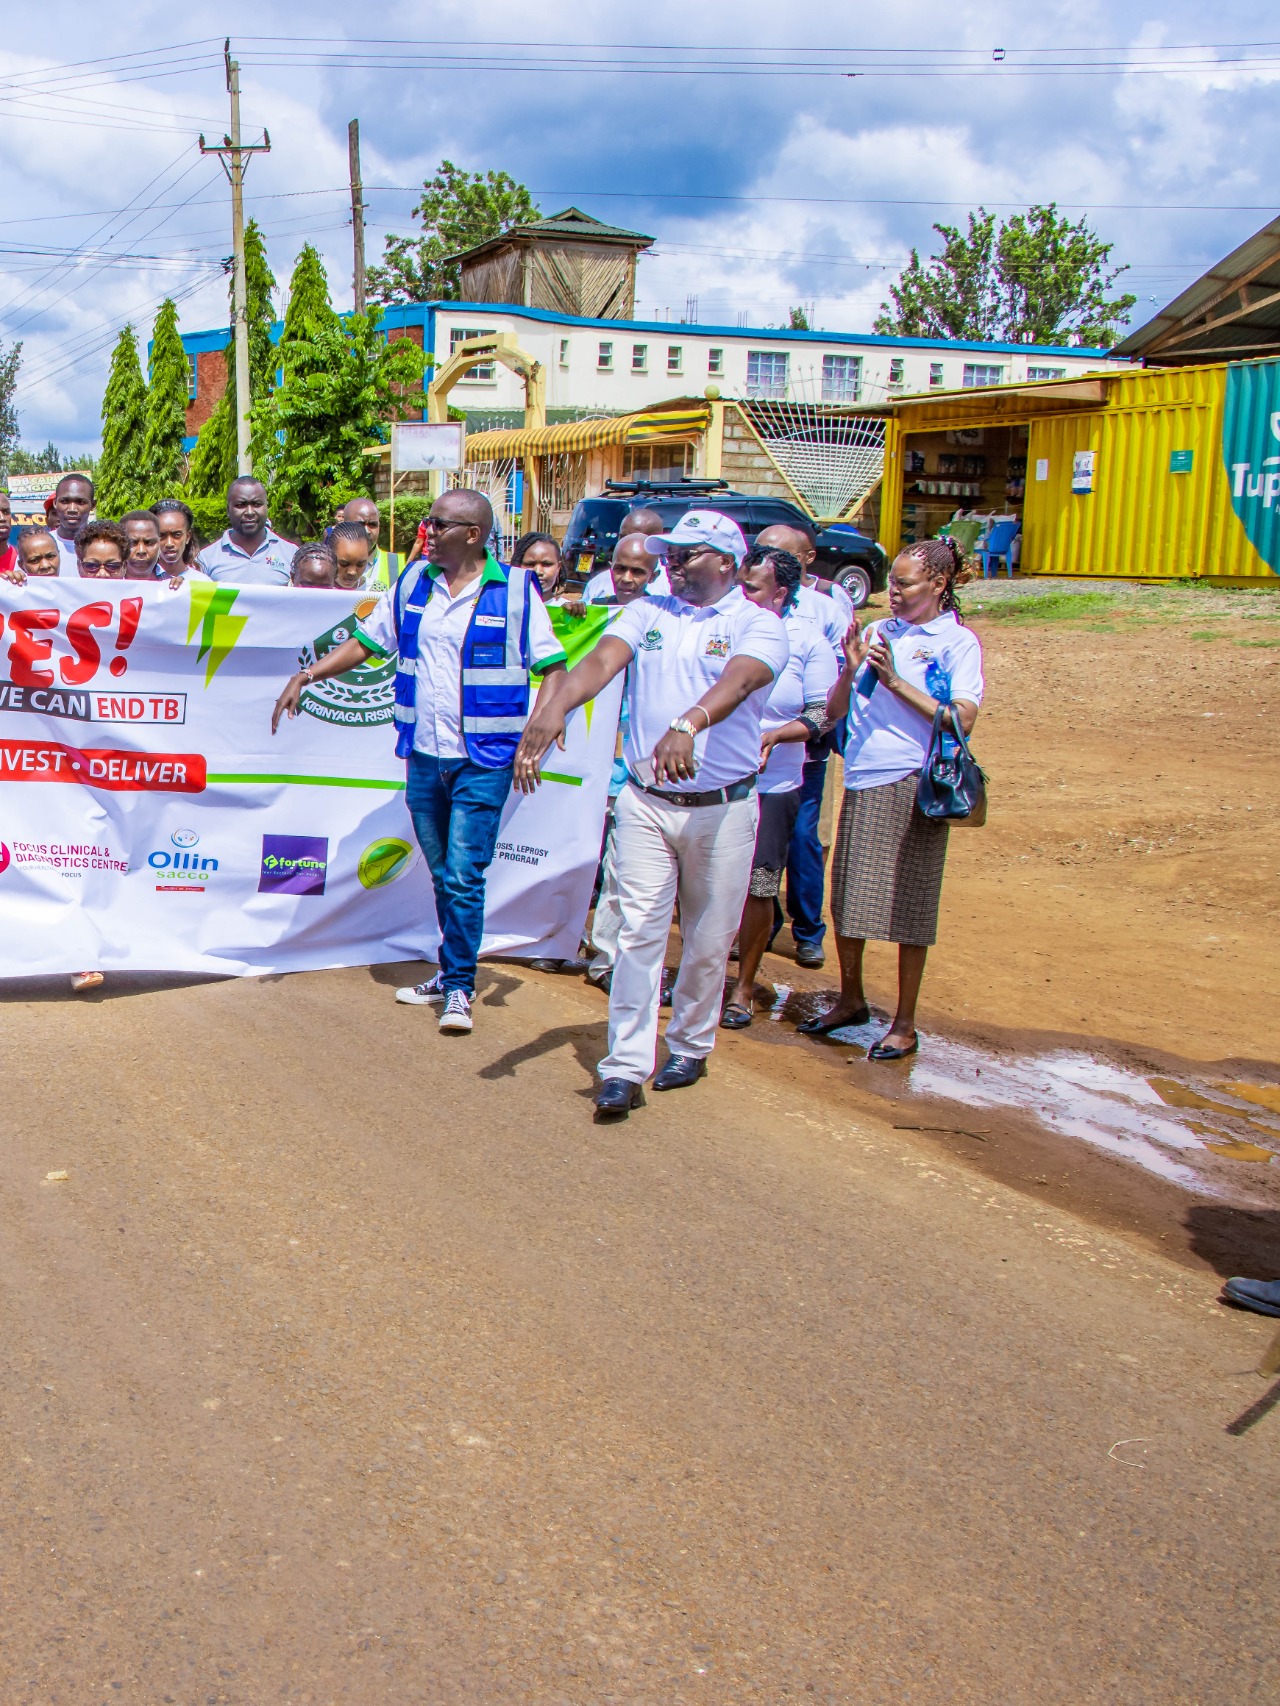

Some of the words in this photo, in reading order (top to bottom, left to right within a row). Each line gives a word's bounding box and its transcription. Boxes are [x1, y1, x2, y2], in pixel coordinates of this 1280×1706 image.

[30, 689, 86, 716] CAN
[97, 697, 144, 719] END
[148, 698, 179, 719] TB
[301, 697, 364, 722] KIRINYAGA
[89, 758, 187, 783] DELIVER
[13, 841, 47, 855] FOCUS
[50, 845, 103, 857] CLINICAL
[104, 847, 110, 857] &
[517, 845, 549, 857] LEPROSY
[148, 851, 219, 871] Ollin
[280, 857, 326, 869] fortune
[499, 852, 539, 866] PROGRAM
[156, 871, 209, 880] sacco
